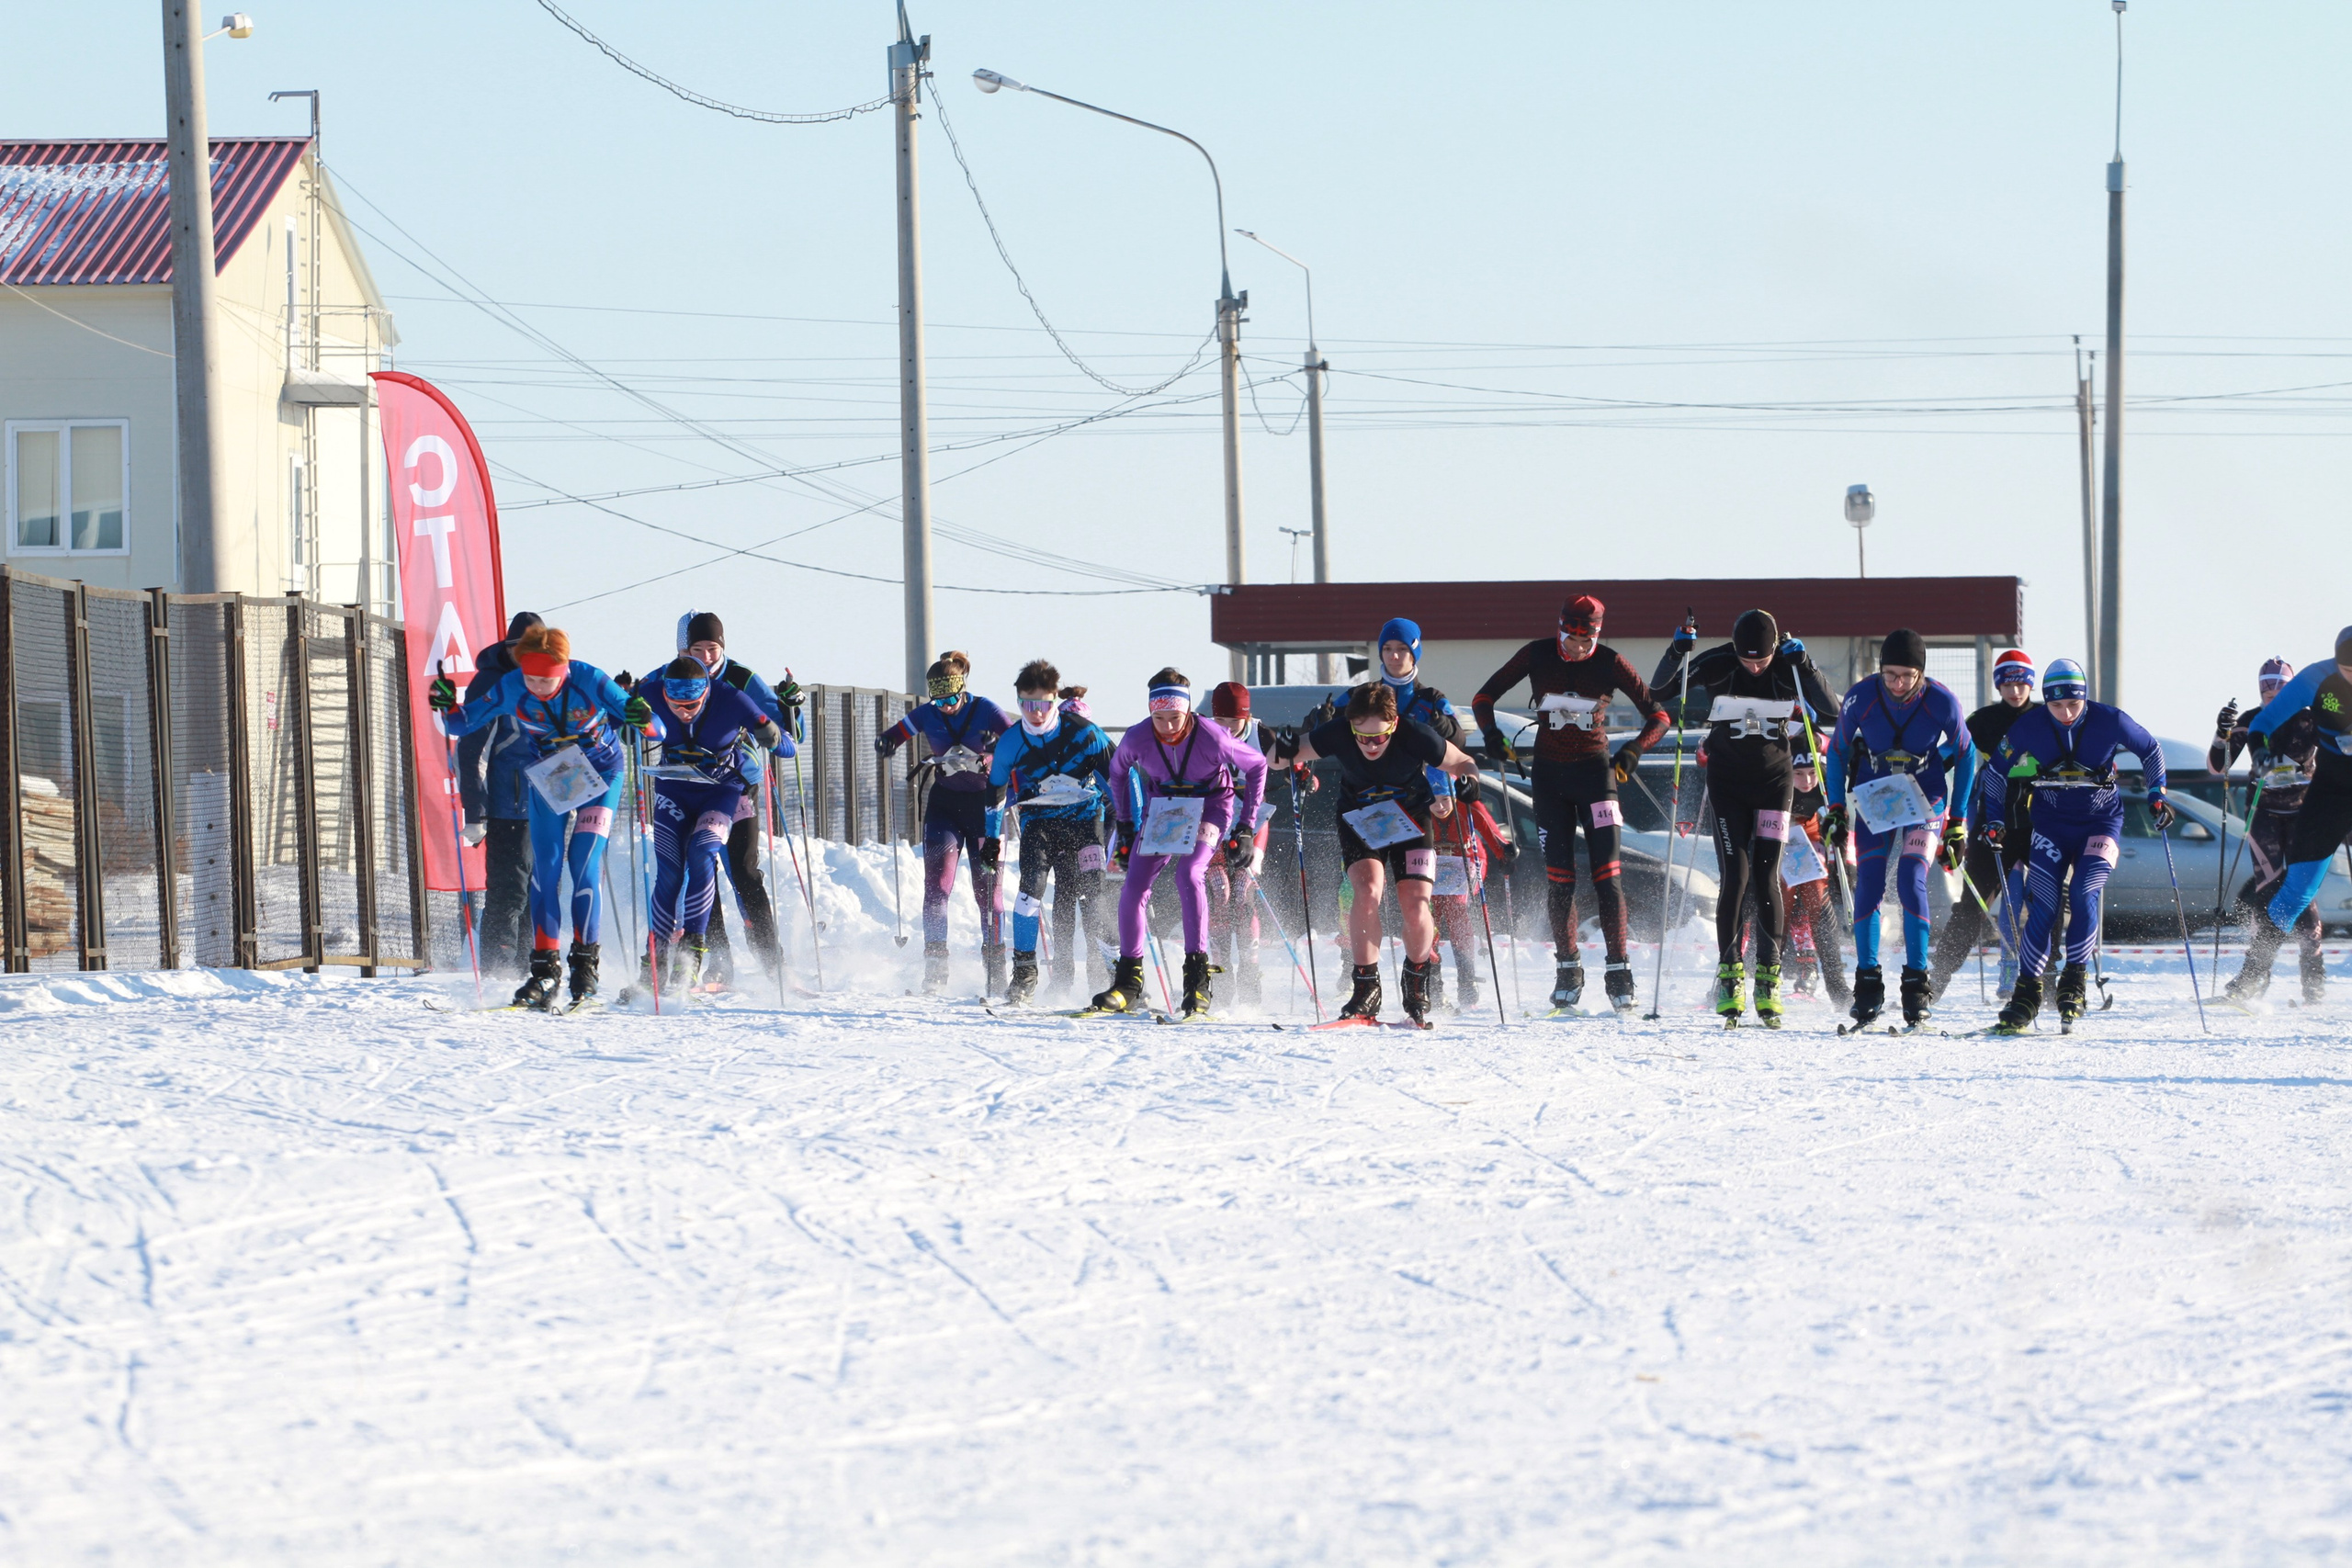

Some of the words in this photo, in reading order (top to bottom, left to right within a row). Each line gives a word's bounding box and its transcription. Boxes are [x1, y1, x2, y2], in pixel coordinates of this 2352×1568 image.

[1598, 809, 1613, 818] 414
[581, 815, 606, 827] 401.1
[1718, 817, 1734, 856] КУРГАН
[1411, 857, 1430, 866] 404
